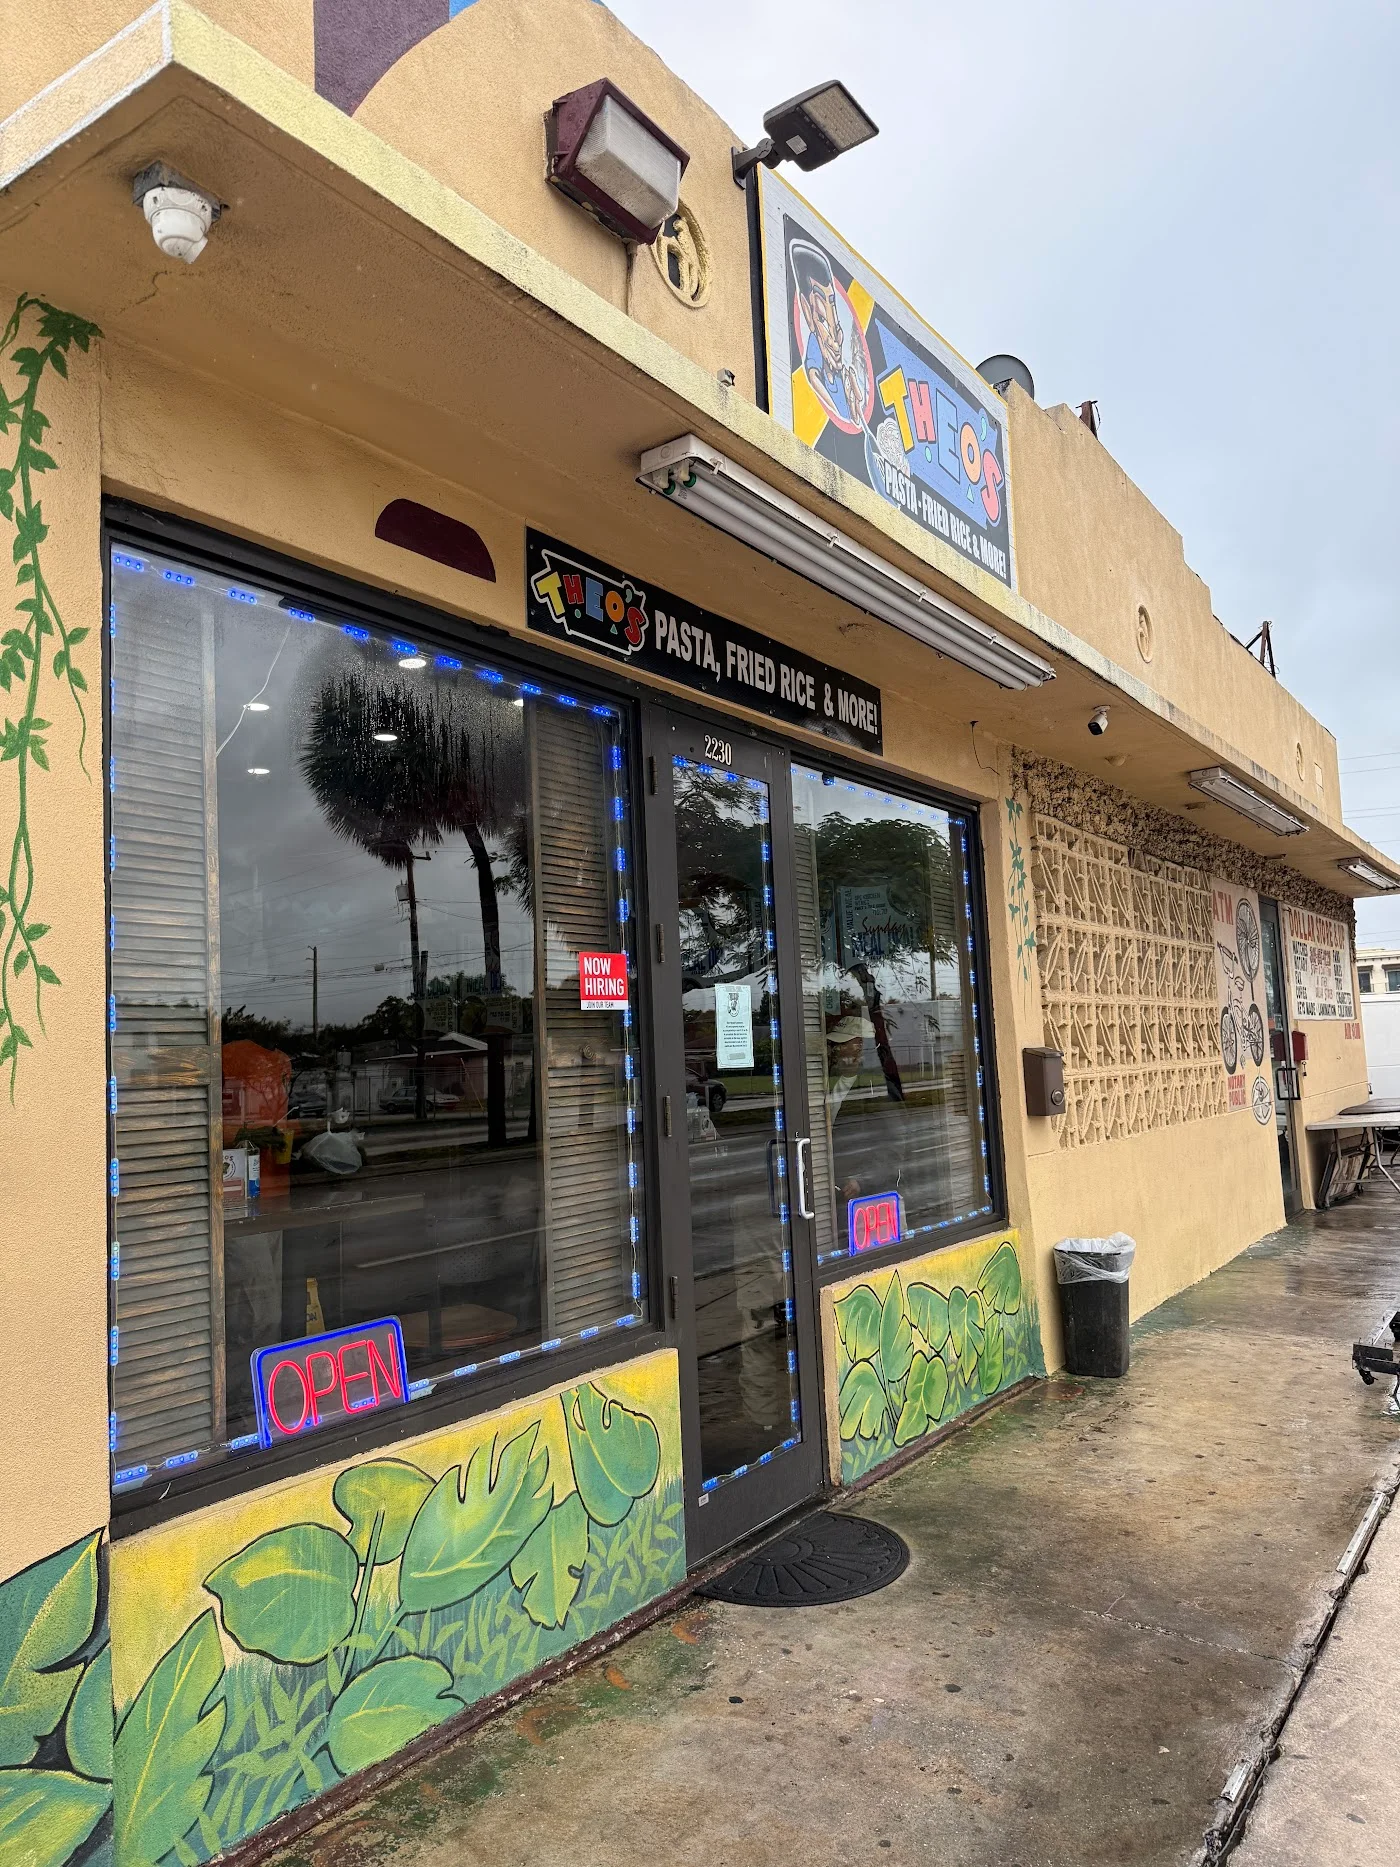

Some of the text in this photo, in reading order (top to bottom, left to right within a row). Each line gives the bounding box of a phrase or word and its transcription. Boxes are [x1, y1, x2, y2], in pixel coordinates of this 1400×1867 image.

[885, 461, 918, 515] PASTA
[921, 491, 949, 537] FRIED
[950, 513, 973, 554] RICE
[973, 535, 980, 560] &
[980, 535, 1006, 579] MORE!
[654, 609, 878, 735] PASTA, FRIED RICE & MORE!
[704, 734, 732, 766] 2230
[1212, 890, 1234, 925] ATM
[1288, 909, 1315, 942] DOLLAR
[1316, 916, 1334, 947] STORE
[584, 957, 611, 975] NOW
[585, 977, 624, 996] HIRING
[604, 1001, 614, 1009] TEAM
[1228, 1074, 1246, 1090] NOTARY
[854, 1200, 898, 1250] OPEN
[268, 1333, 400, 1434] OPEN
